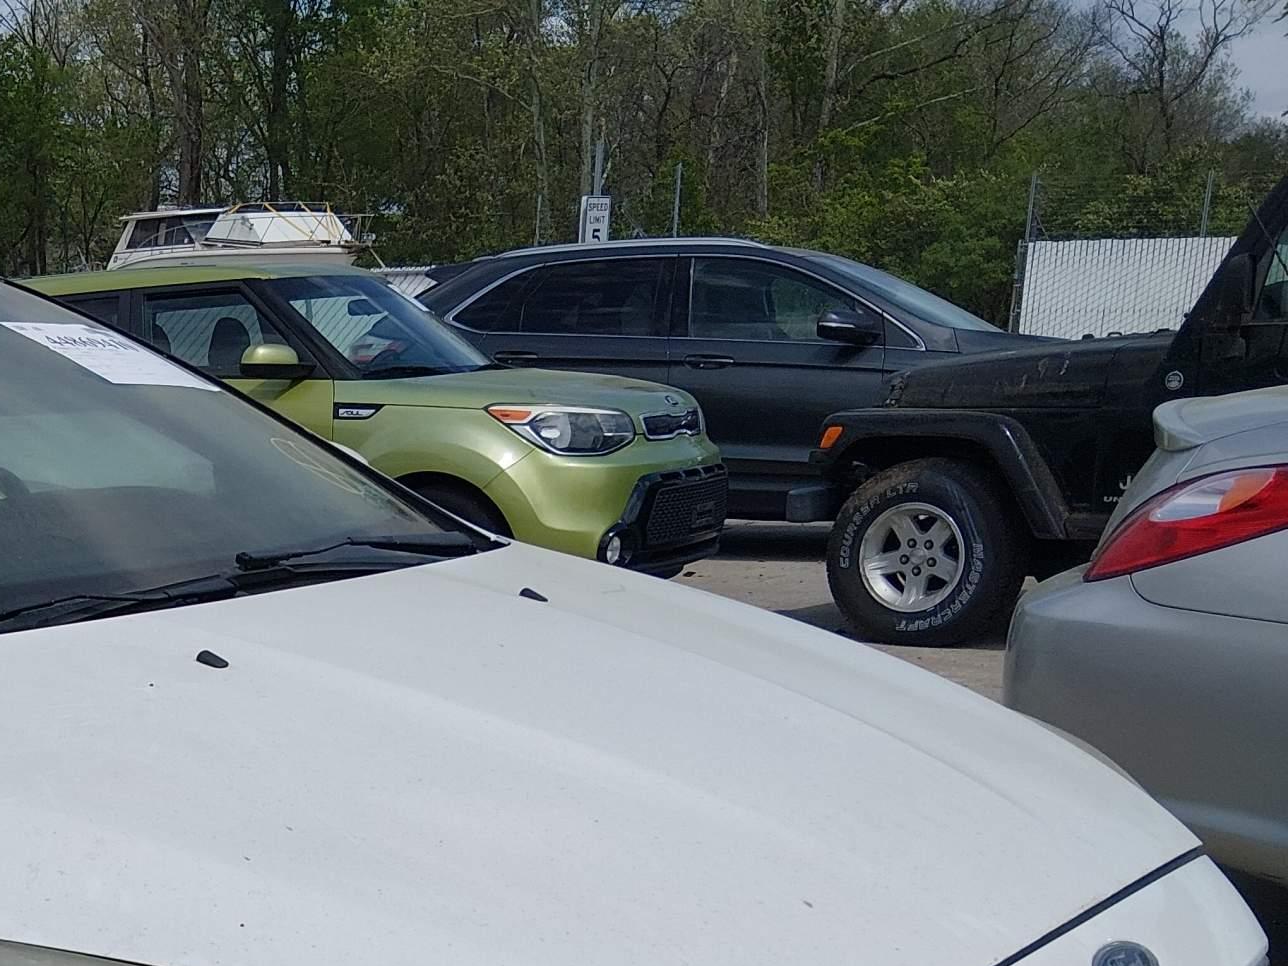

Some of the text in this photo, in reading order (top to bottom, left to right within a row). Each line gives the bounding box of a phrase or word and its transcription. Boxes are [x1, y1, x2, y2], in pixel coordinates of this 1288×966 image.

[588, 203, 608, 211] SPEED
[589, 216, 605, 224] LIMIT
[592, 229, 600, 242] 5
[839, 482, 919, 568] COURSER LTR
[896, 543, 985, 631] MASTERCRAFT
